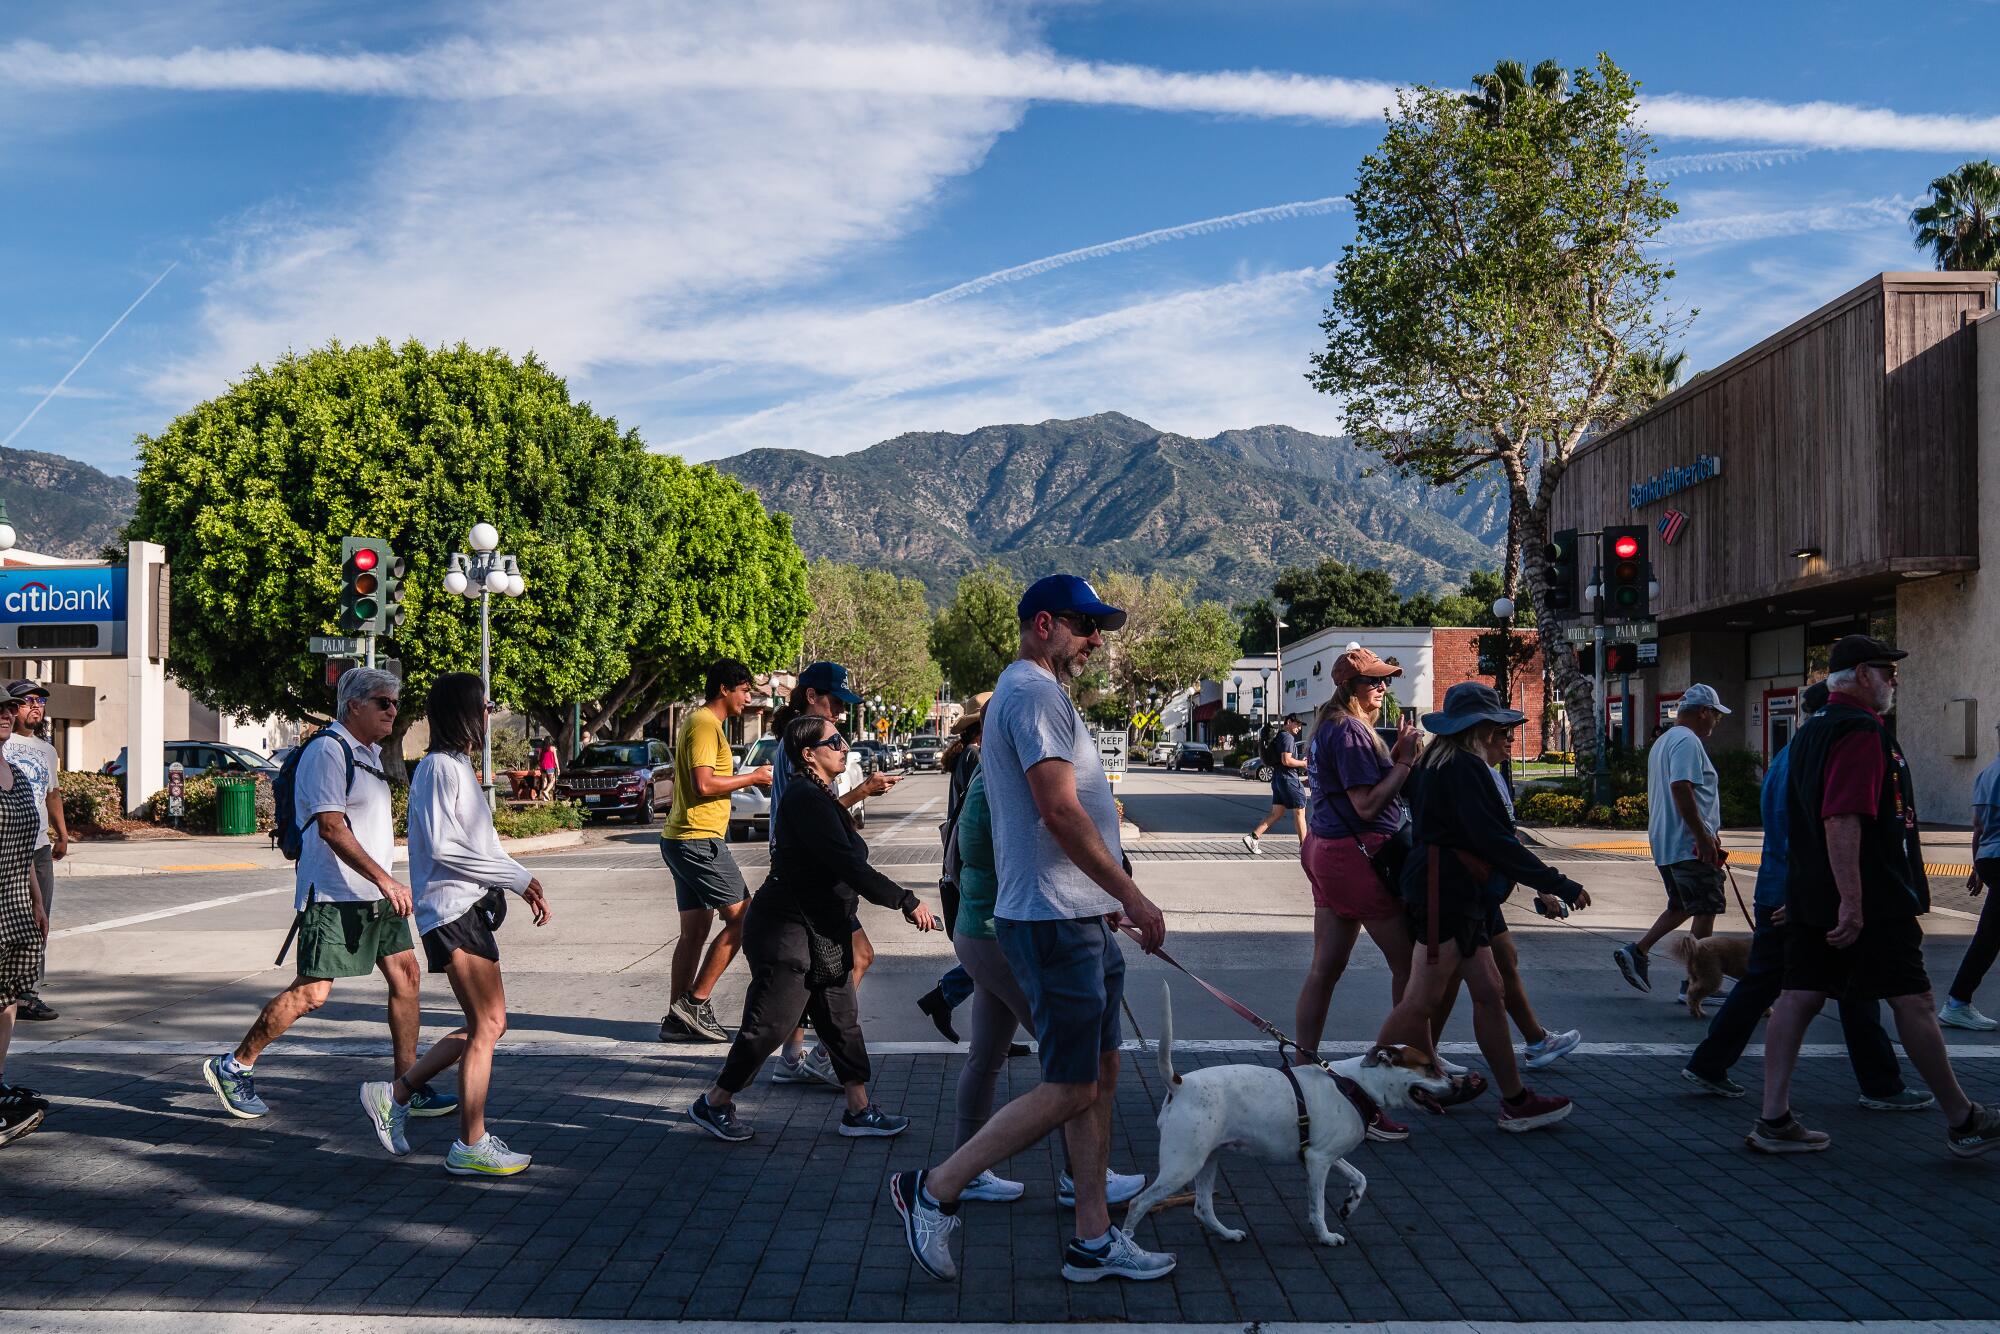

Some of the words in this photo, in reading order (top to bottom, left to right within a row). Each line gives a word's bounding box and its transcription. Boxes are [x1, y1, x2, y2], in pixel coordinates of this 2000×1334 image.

[5, 583, 111, 613] citibank
[1615, 624, 1638, 638] PALM
[322, 639, 345, 652] PALM
[1100, 736, 1123, 745] KEEP
[1100, 758, 1124, 767] RIGHT
